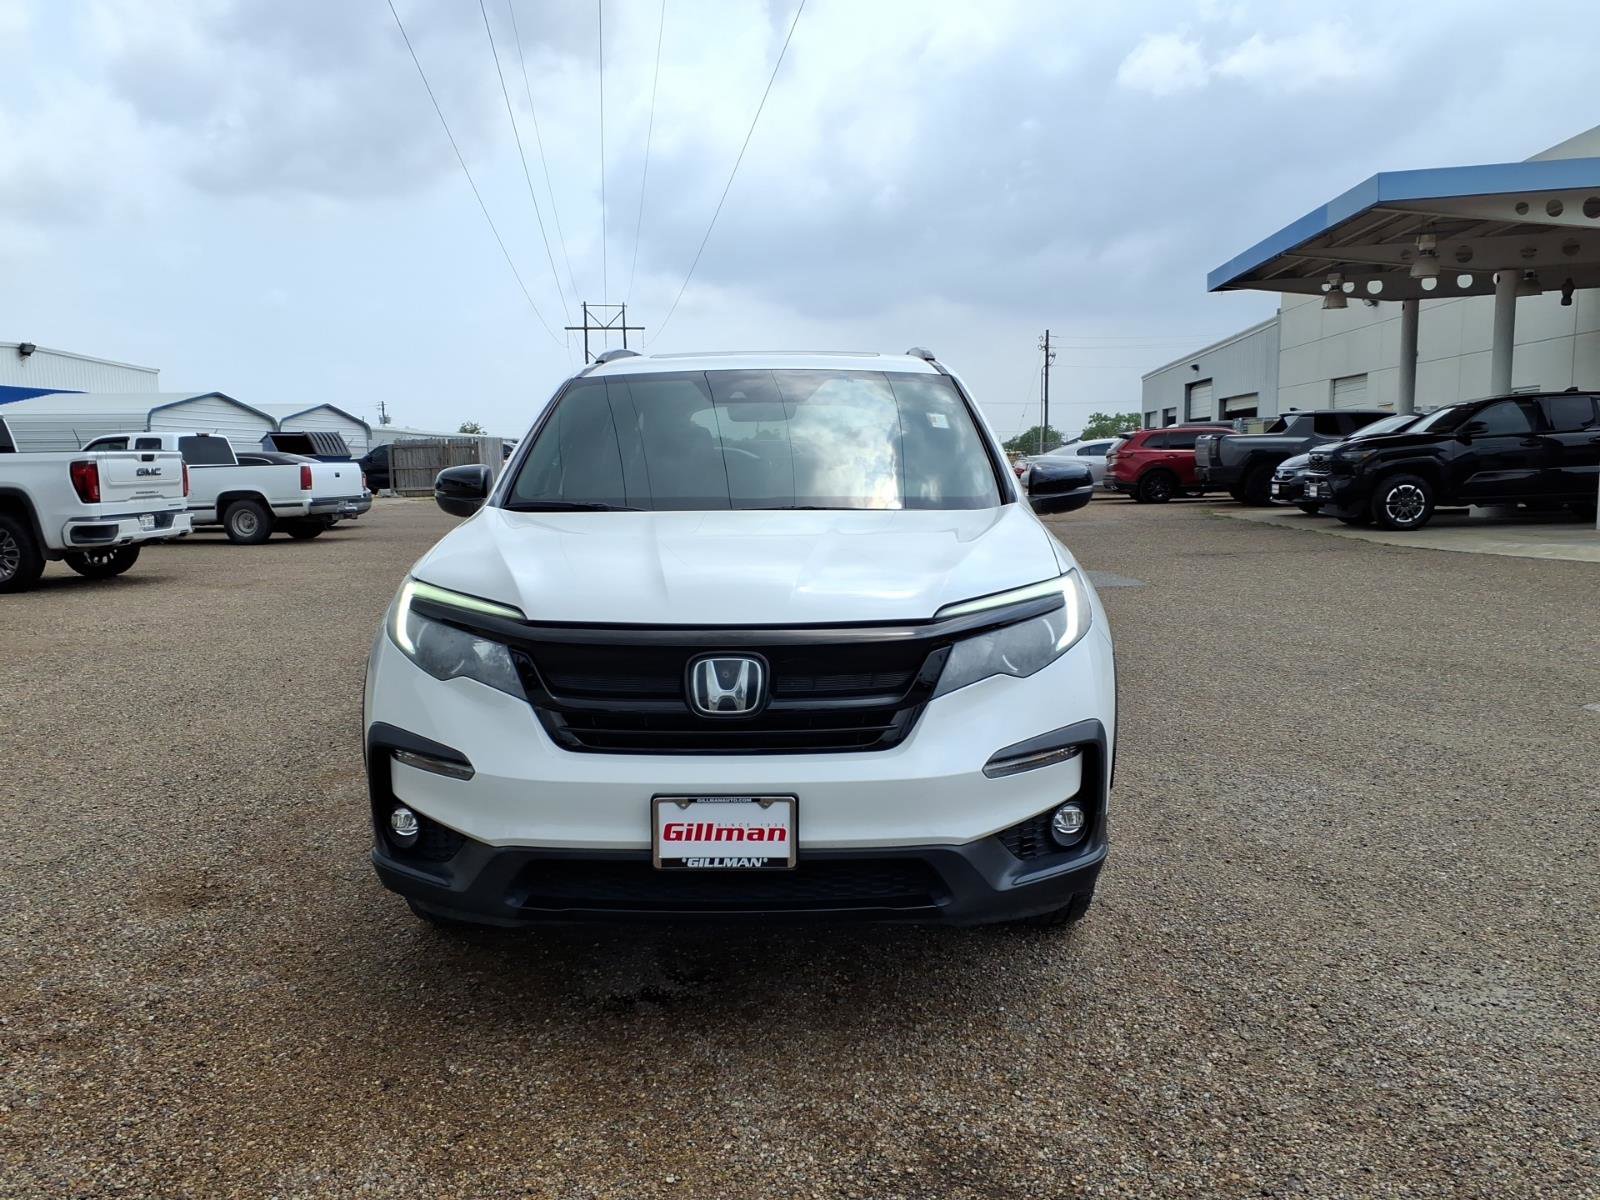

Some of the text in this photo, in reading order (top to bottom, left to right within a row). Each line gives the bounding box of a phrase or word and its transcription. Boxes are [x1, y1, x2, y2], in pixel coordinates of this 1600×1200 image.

[136, 468, 162, 477] GMC
[663, 823, 787, 842] Gillman
[687, 858, 762, 868] GILLMAN
